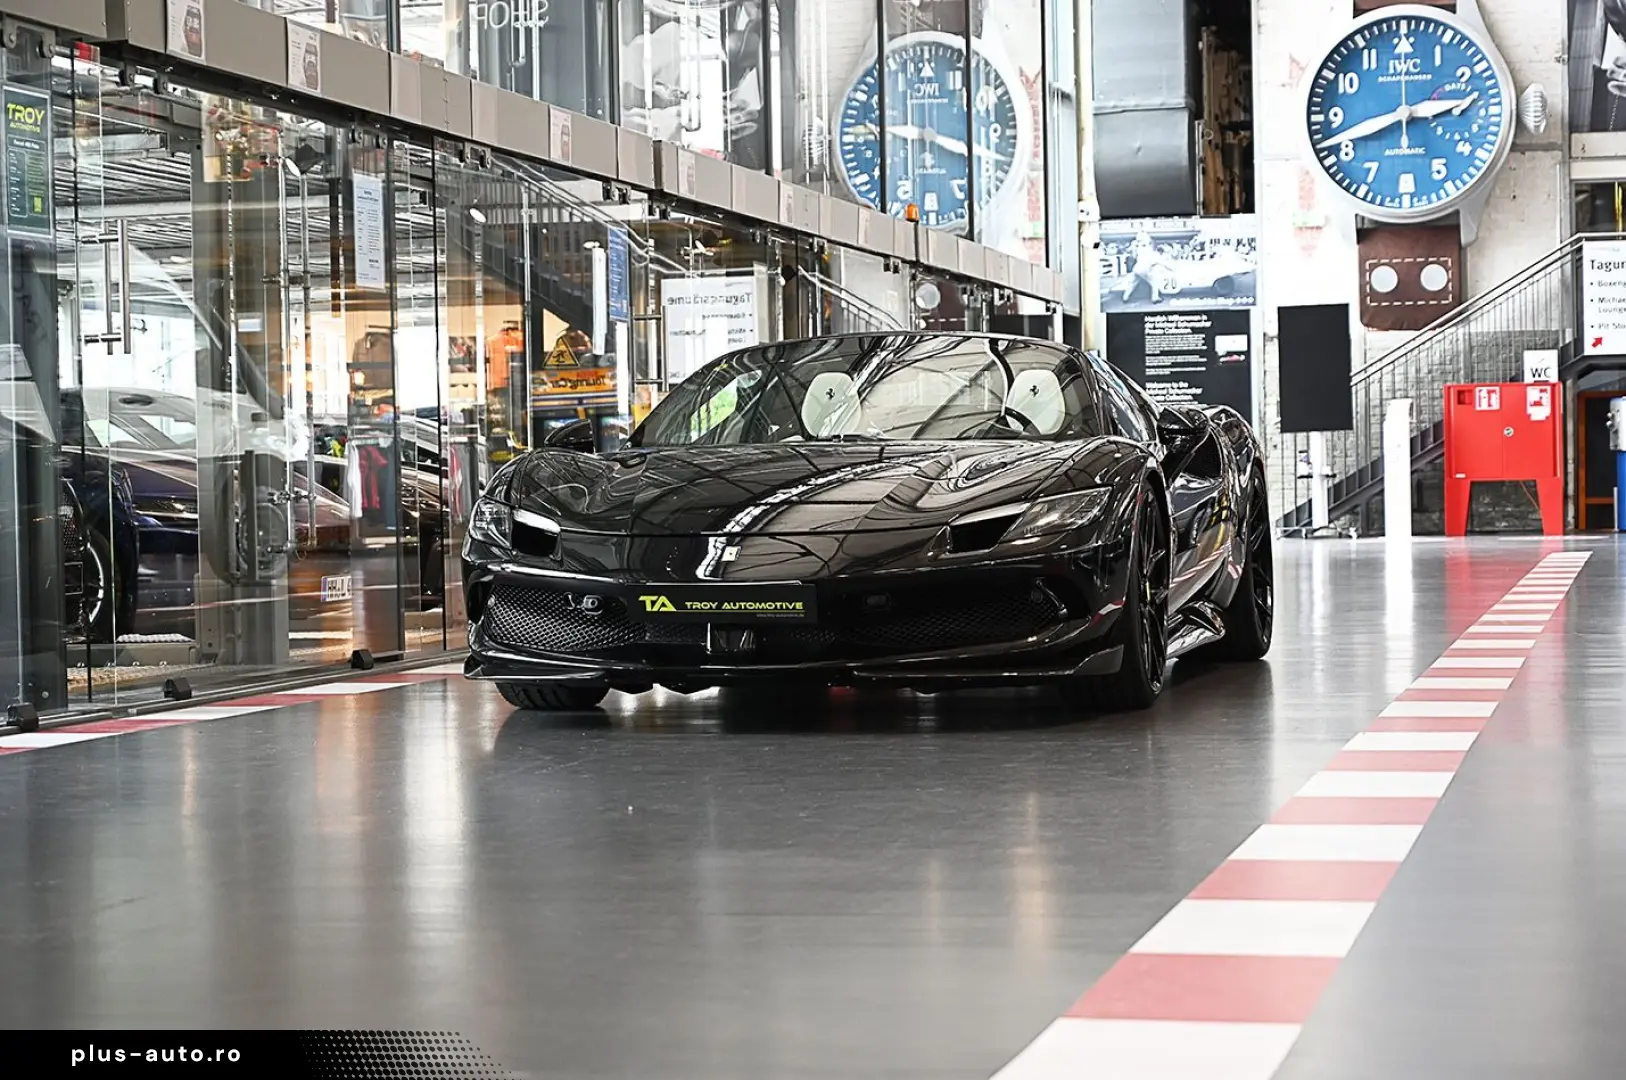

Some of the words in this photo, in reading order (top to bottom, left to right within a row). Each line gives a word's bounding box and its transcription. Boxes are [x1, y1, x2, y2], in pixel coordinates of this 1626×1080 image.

[1388, 58, 1421, 74] IWC
[1338, 72, 1360, 94] 10
[7, 102, 45, 126] TROY
[1328, 106, 1345, 129] 9
[1339, 139, 1355, 161] 8
[1384, 147, 1426, 156] AUTOMATIC
[1455, 140, 1472, 157] 4
[1362, 161, 1379, 184] 7
[1431, 158, 1448, 180] 5
[1163, 278, 1177, 289] 20
[1530, 366, 1552, 379] WC
[638, 595, 677, 612] TA
[685, 601, 718, 610] TROY
[721, 601, 804, 610] AUTOMOTIVE
